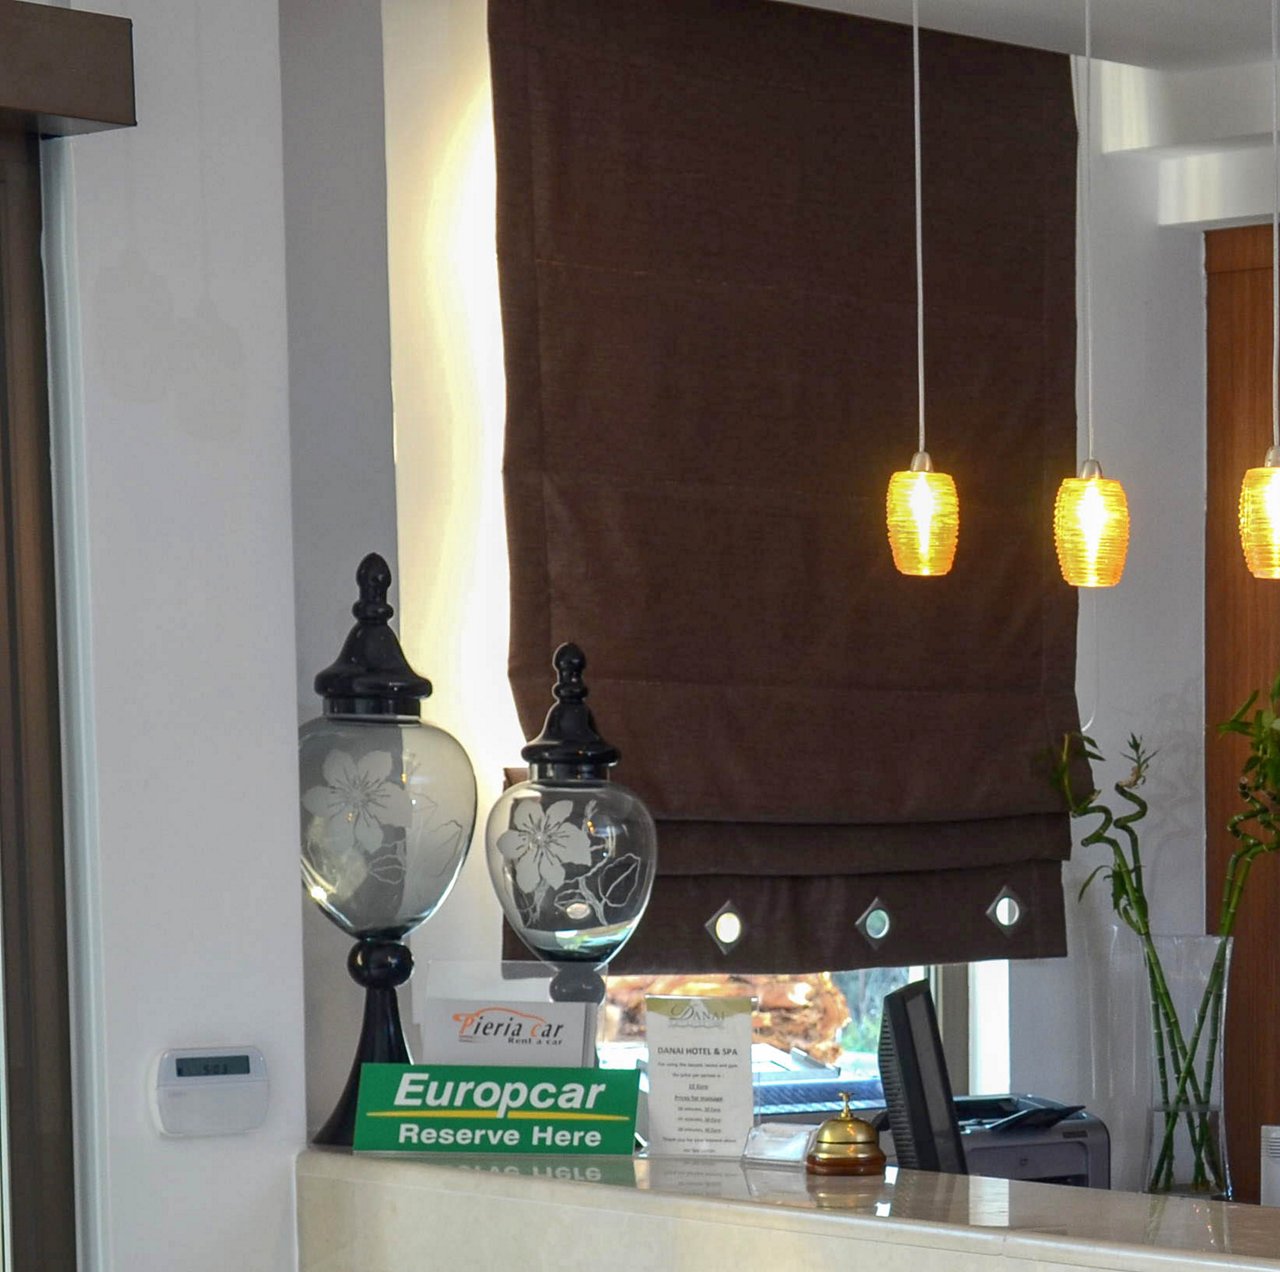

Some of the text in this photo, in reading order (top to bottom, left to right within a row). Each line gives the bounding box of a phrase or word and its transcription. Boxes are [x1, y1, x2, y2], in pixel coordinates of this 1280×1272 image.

[452, 1013, 523, 1036] Pieria
[508, 1037, 532, 1045] Rent
[546, 1038, 563, 1046] car
[657, 1046, 738, 1056] DANAI HOTEL & SPA
[394, 1072, 606, 1119] Europcar
[398, 1123, 602, 1147] Reserve Here
